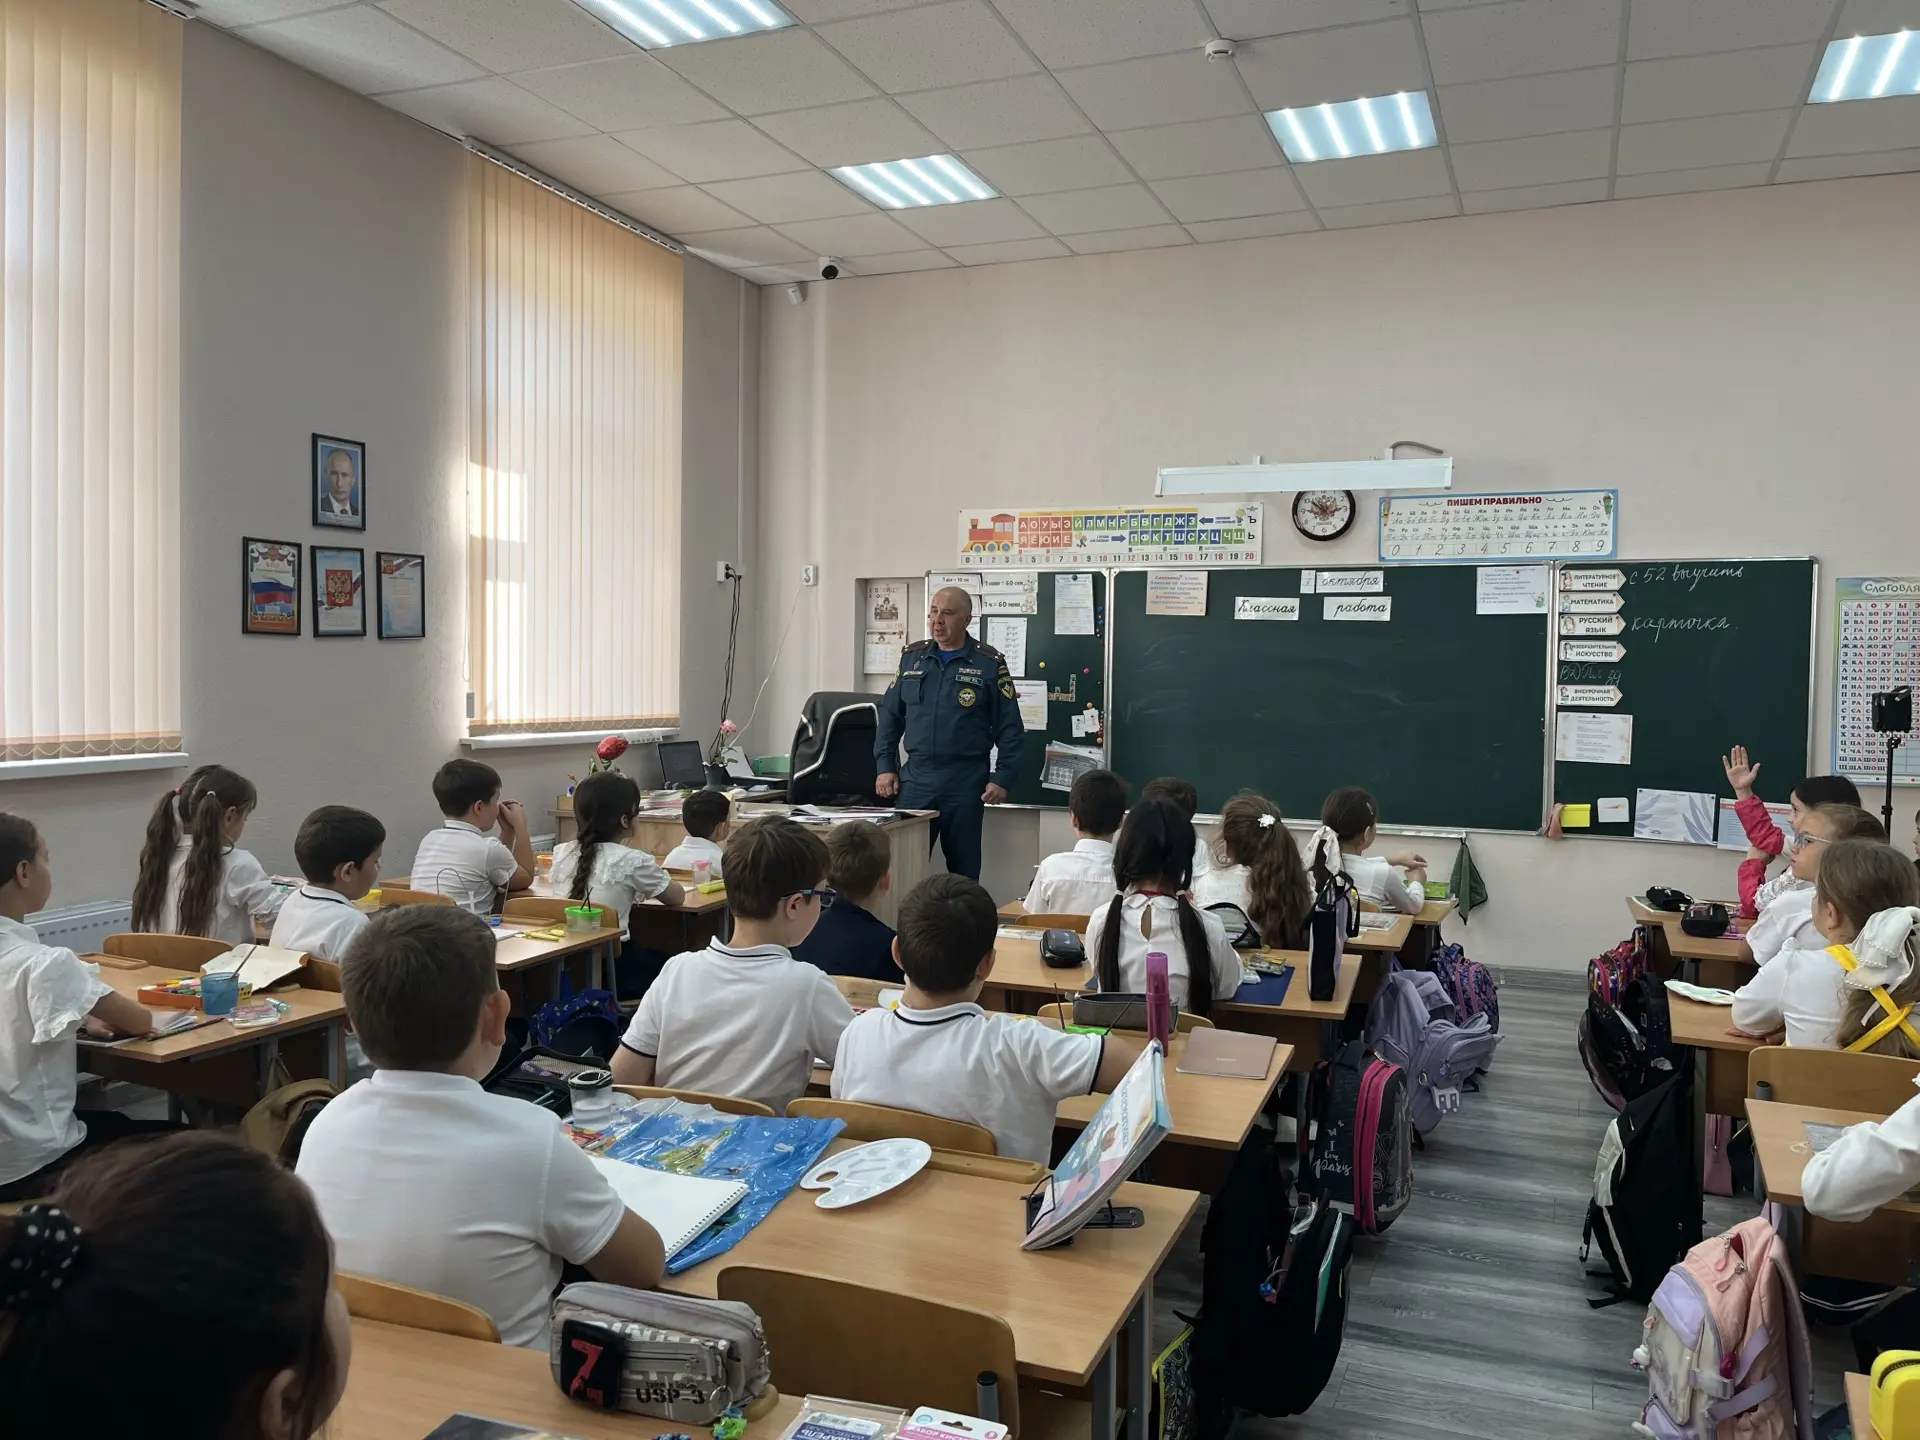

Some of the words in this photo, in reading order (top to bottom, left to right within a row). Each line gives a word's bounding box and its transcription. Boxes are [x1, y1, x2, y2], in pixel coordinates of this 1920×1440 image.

[1447, 498, 1482, 506] ПИШЕМ
[1484, 496, 1542, 505] ПРАВИЛЬНО
[1075, 519, 1081, 528] Й
[1164, 518, 1172, 526] Д
[1031, 534, 1036, 543] Ё
[1211, 532, 1219, 541] Ц
[1234, 532, 1244, 541] Щ
[1392, 545, 1400, 556] 0
[1416, 545, 1422, 555] 1
[1435, 544, 1443, 555] 2
[1458, 544, 1465, 555] 3
[1481, 543, 1488, 554] 4
[1501, 543, 1510, 554] 5
[1526, 542, 1533, 553] 6
[1548, 541, 1556, 552] 7
[1572, 541, 1580, 552] 8
[1596, 540, 1604, 552] 9
[1322, 572, 1380, 590] октября
[1644, 567, 1666, 583] 52
[1238, 600, 1296, 613] Классная
[1333, 599, 1387, 617] работа
